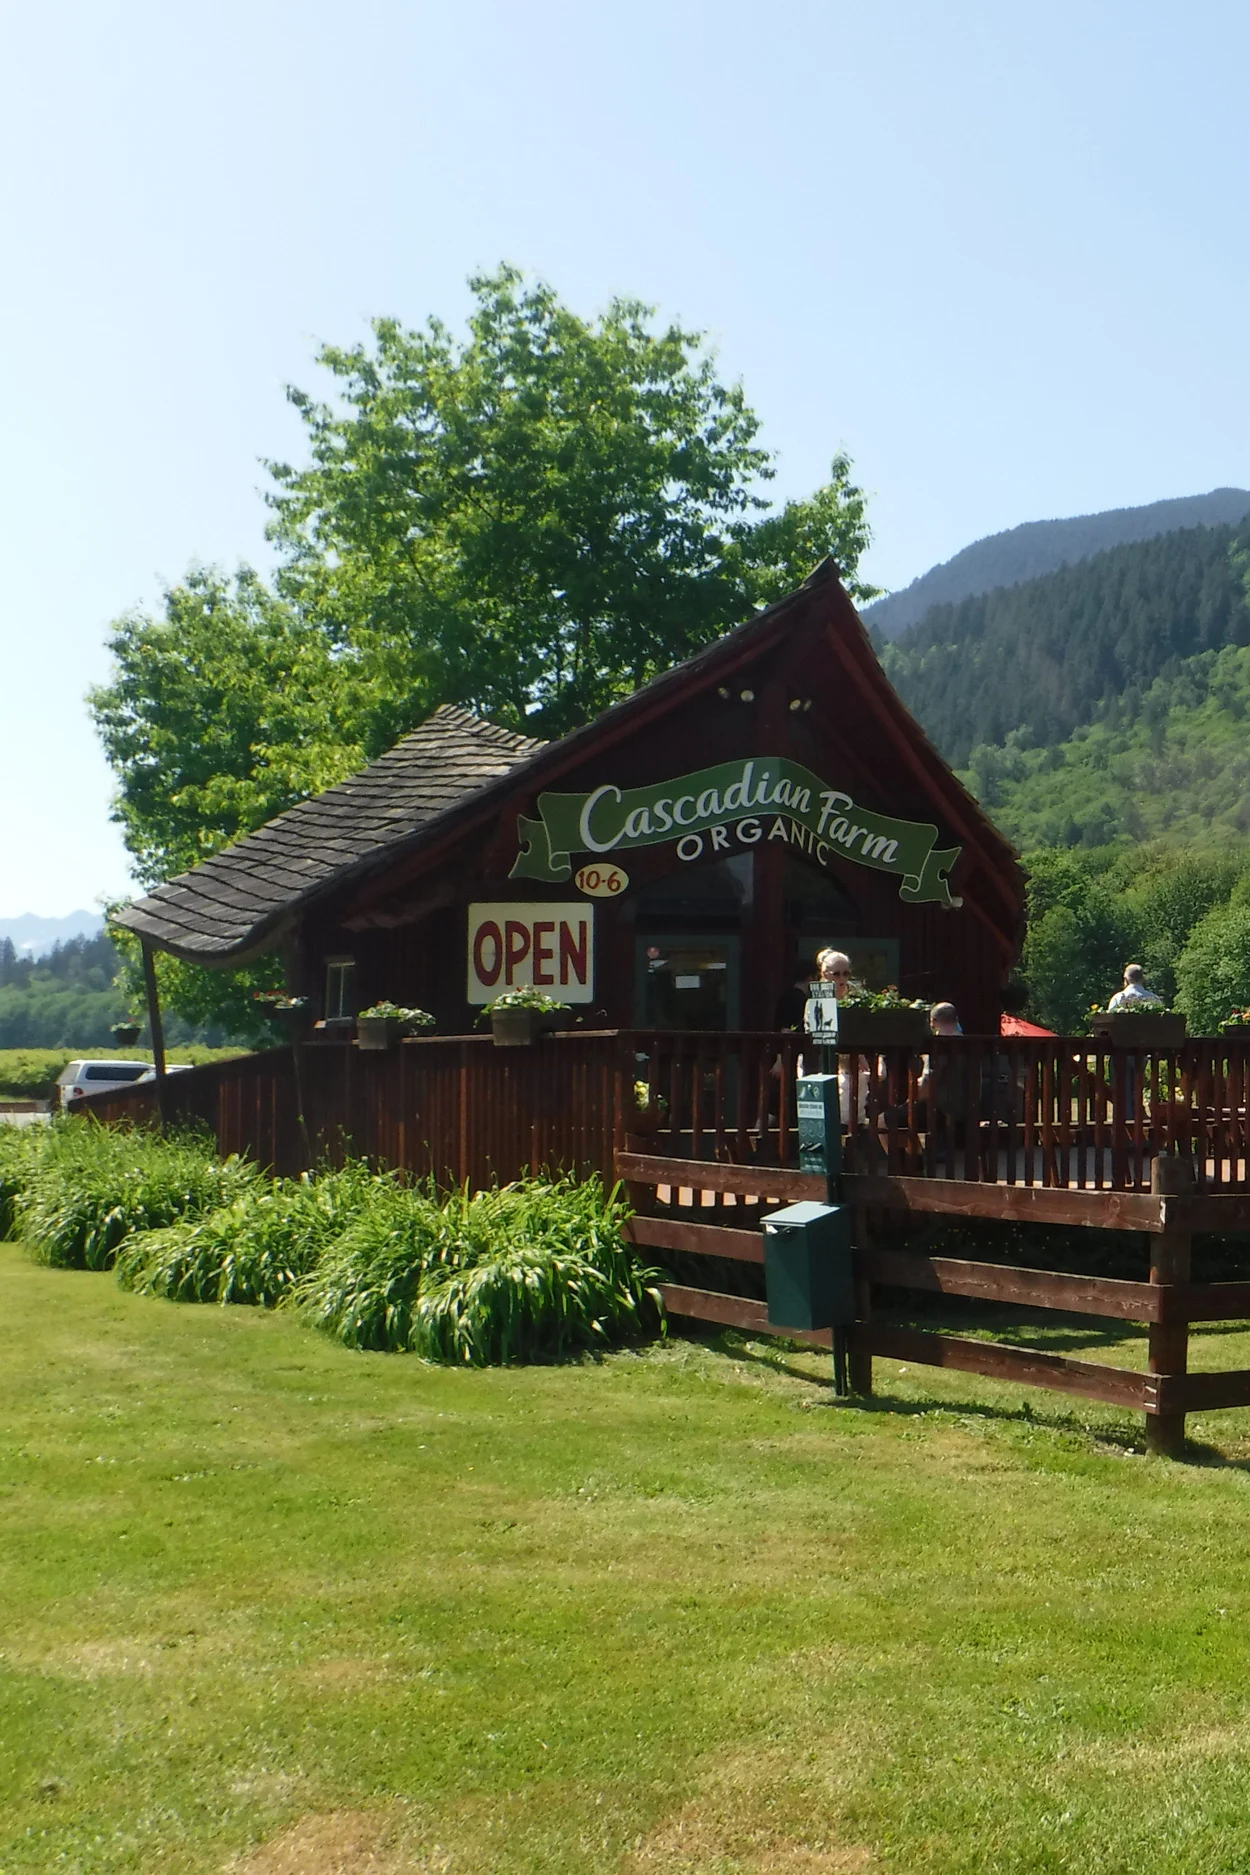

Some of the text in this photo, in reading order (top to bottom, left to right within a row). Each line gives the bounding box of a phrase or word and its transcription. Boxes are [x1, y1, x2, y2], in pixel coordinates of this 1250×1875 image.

[580, 762, 899, 863] Cascadian Farm
[676, 817, 830, 866] ORGANIC
[578, 870, 622, 893] 10-6
[473, 920, 587, 986] OPEN
